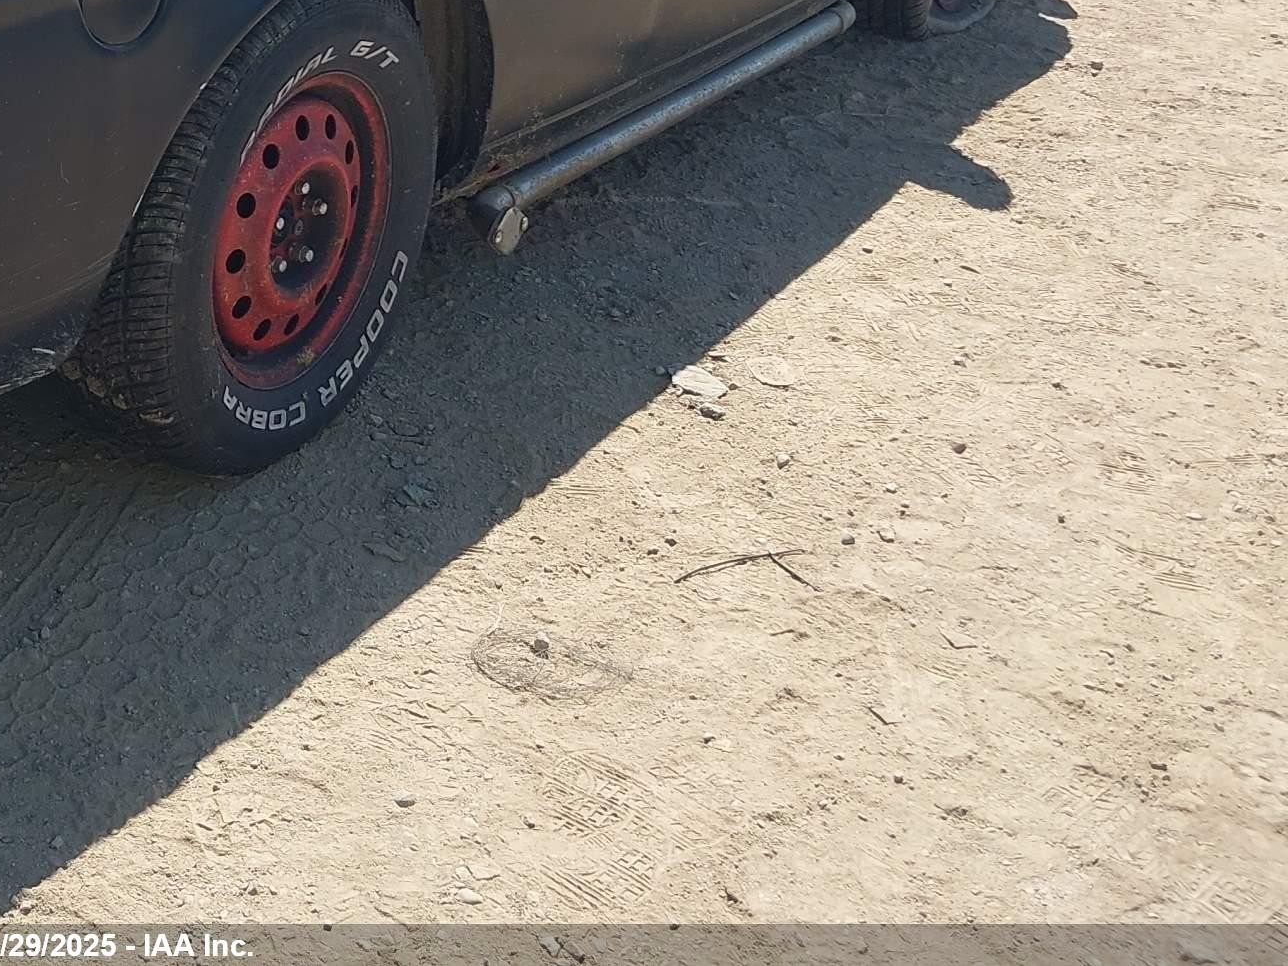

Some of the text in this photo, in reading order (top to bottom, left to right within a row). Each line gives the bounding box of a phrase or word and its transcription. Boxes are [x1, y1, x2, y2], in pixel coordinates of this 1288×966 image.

[350, 39, 400, 69] G/T
[223, 250, 409, 431] COOPER COBRA
